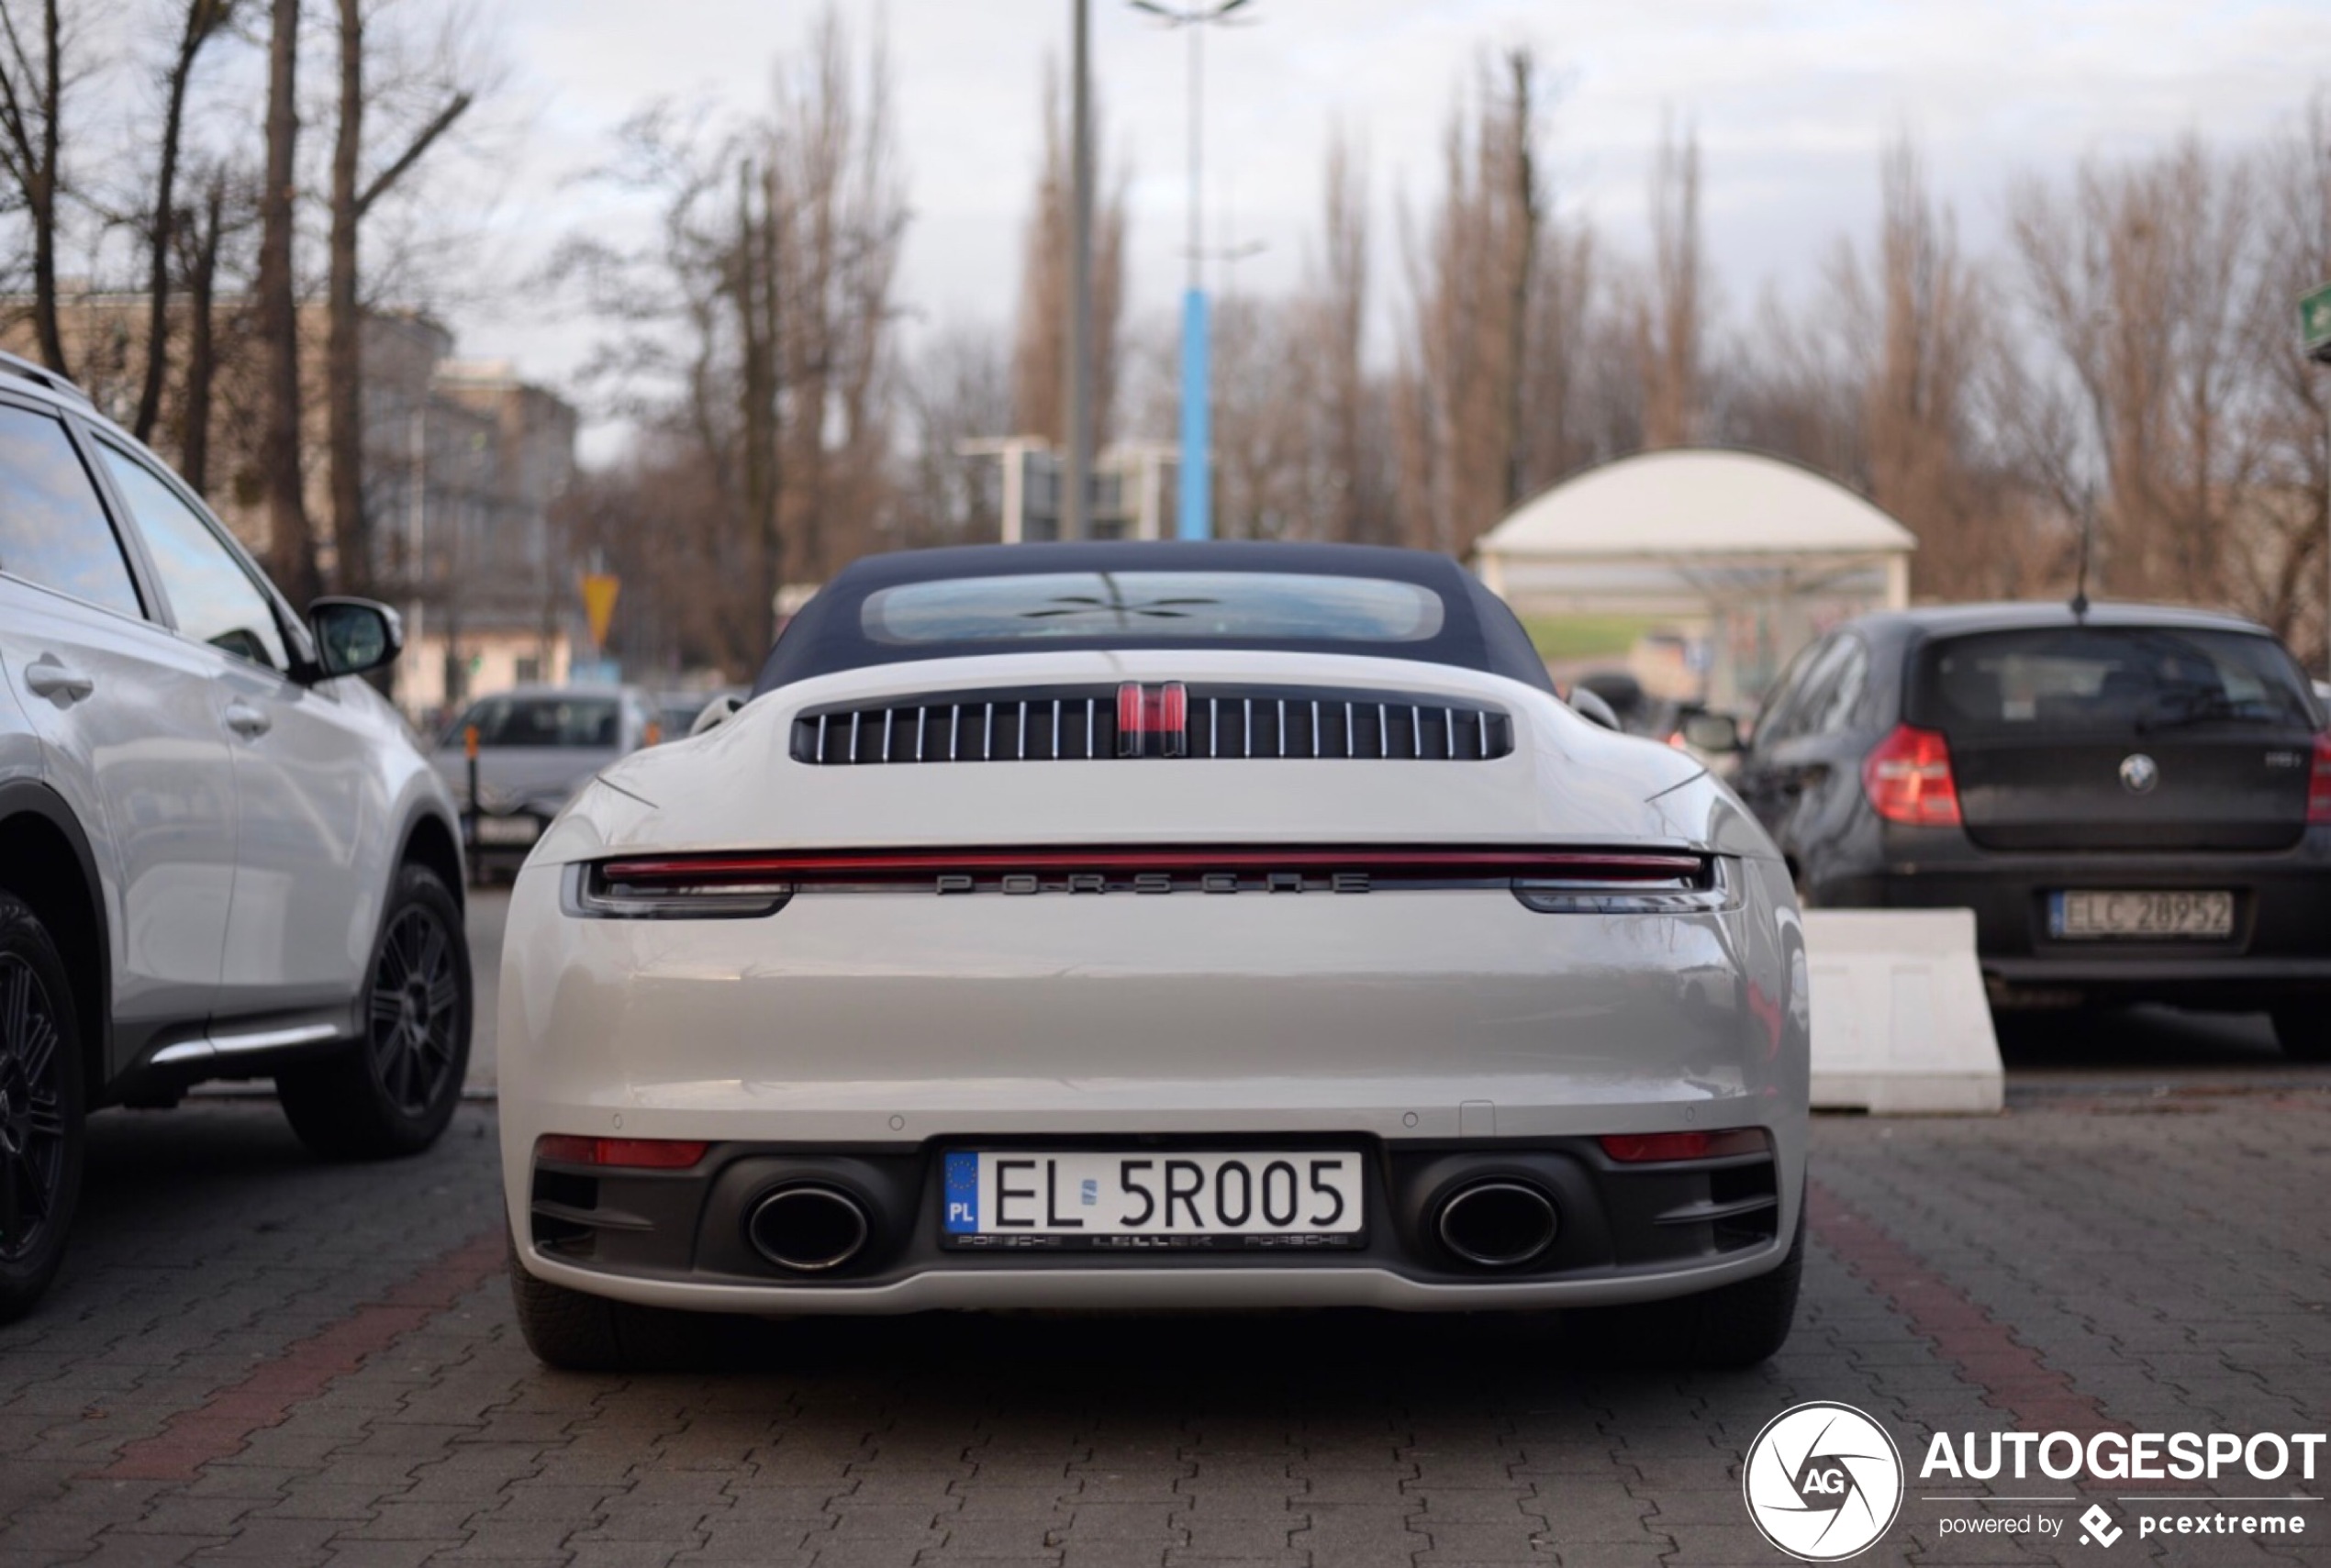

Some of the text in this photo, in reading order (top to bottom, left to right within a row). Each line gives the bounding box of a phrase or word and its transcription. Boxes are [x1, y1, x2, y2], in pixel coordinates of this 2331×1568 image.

[936, 873, 1370, 895] PORSCHE
[2067, 893, 2125, 930] ELC
[996, 1160, 1344, 1228] EL 5R005
[950, 1203, 974, 1222] PL
